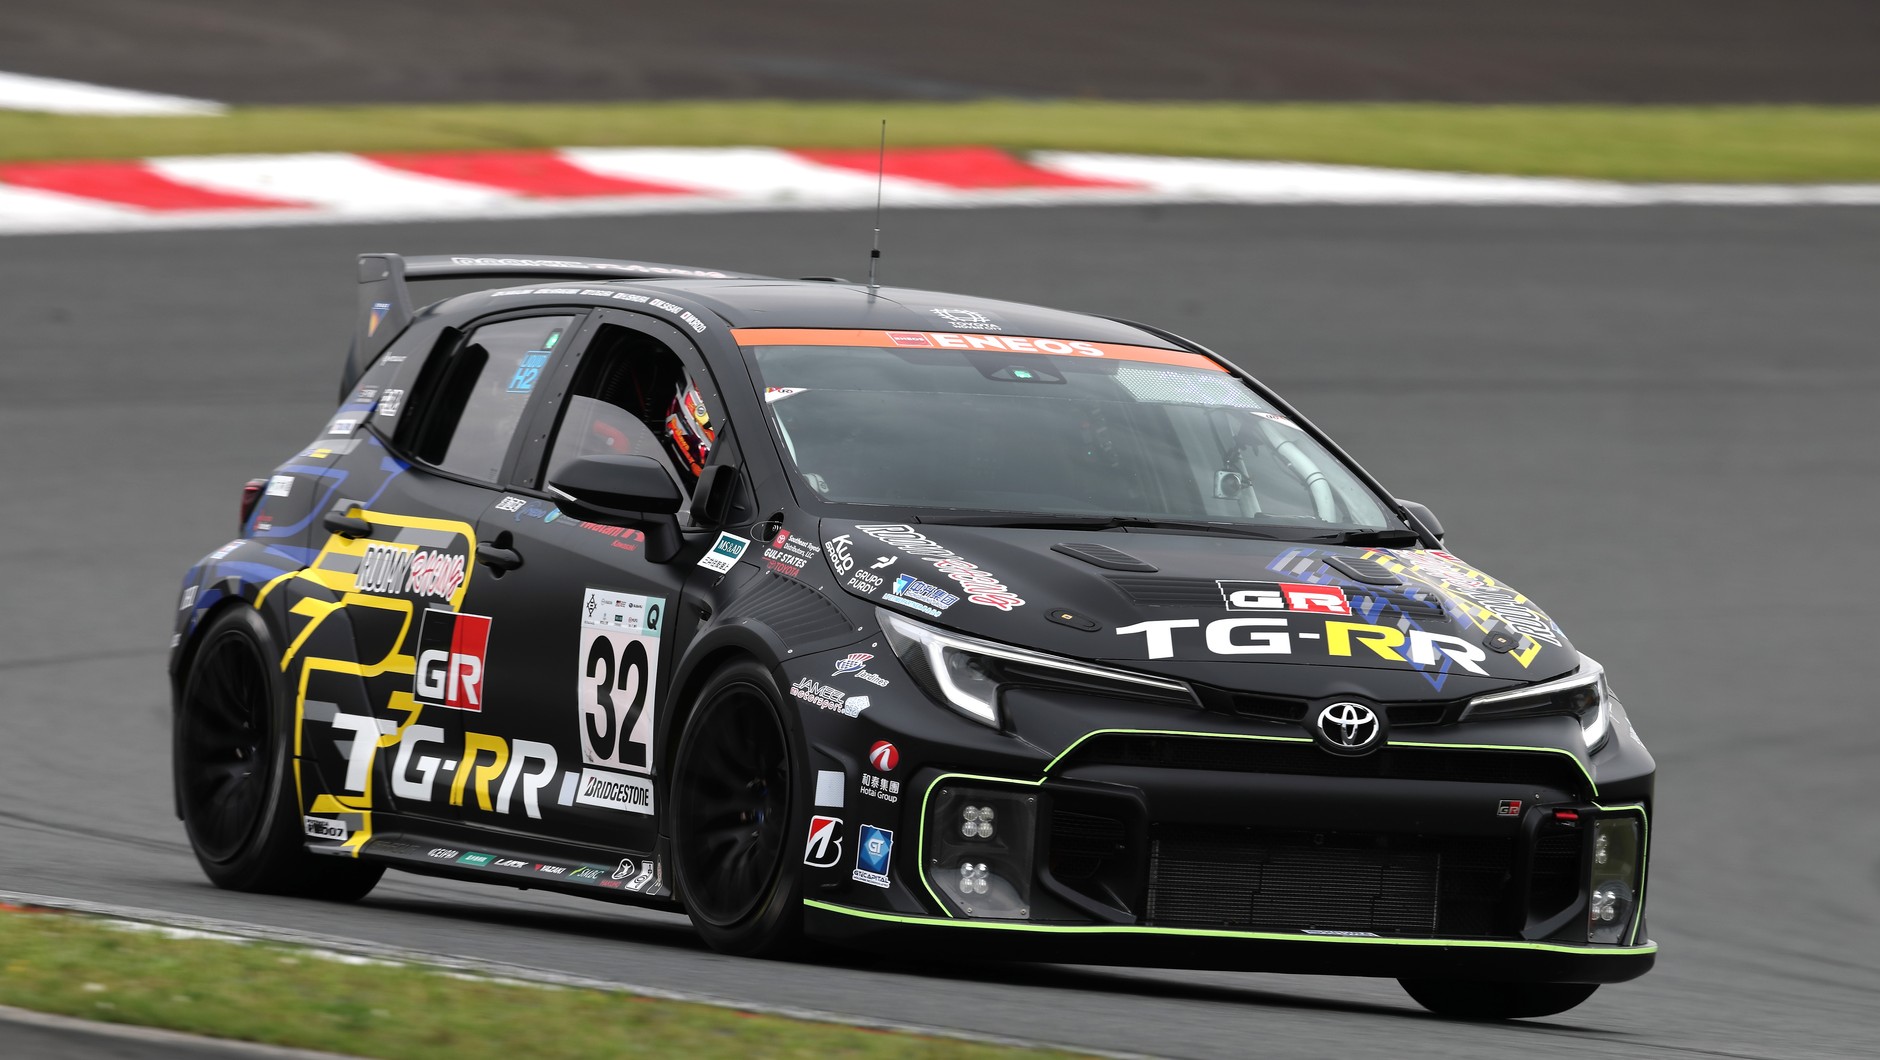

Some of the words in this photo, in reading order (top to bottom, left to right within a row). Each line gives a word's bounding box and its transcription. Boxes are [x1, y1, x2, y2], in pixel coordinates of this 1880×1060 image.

[931, 333, 1105, 357] ENEOS
[509, 368, 539, 389] H2
[718, 540, 742, 555] MS&AD
[788, 535, 810, 549] Southeast
[808, 541, 821, 553] Toyota
[764, 548, 783, 561] GULF
[781, 552, 807, 569] STATES
[825, 541, 845, 577] GROUP
[774, 562, 800, 577] TOYOTA
[854, 568, 883, 586] GRUPO
[847, 577, 877, 595] PURDY
[1229, 588, 1348, 612] GR
[647, 604, 660, 630] Q
[1116, 618, 1490, 676] TG-RR
[416, 649, 482, 705] GR
[854, 670, 890, 688] Jardines
[792, 677, 846, 704] JAMEEL
[585, 635, 649, 768] 32
[331, 713, 559, 820] TG-RR
[584, 777, 649, 807] BRIDGESTONE
[860, 786, 877, 797] Hotai
[877, 791, 898, 803] Group
[862, 773, 900, 795] 和泰集團
[1500, 806, 1519, 815] GR
[868, 838, 884, 854] GT
